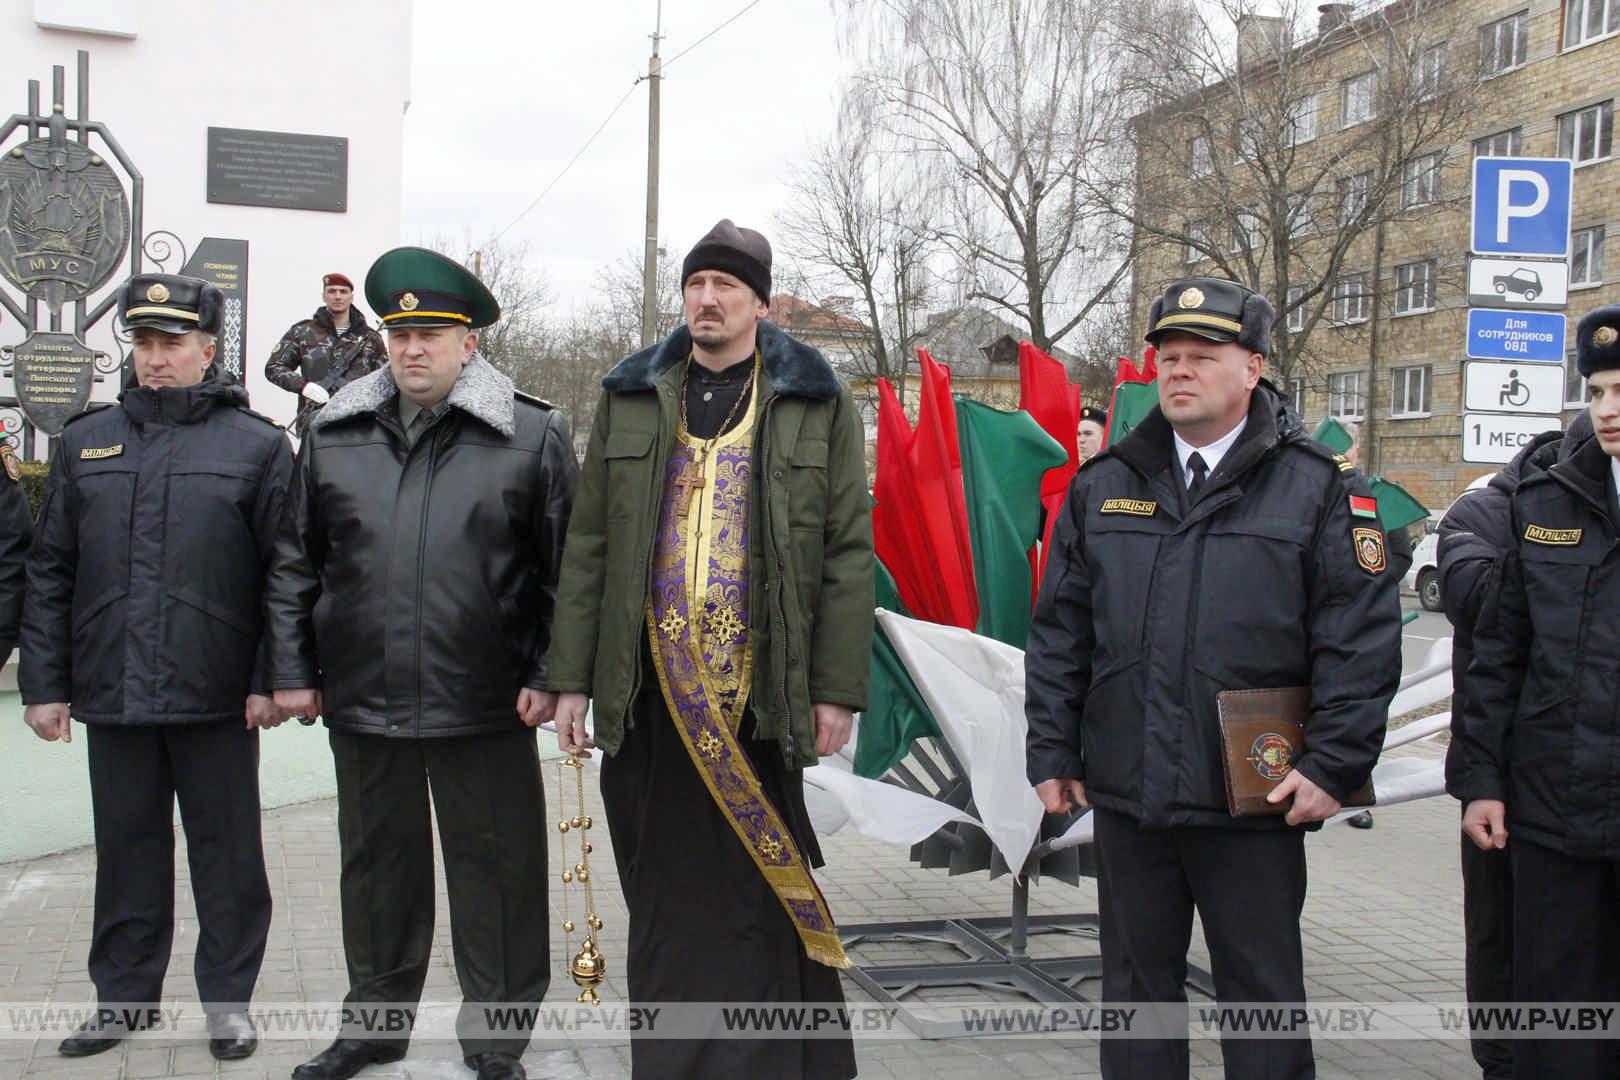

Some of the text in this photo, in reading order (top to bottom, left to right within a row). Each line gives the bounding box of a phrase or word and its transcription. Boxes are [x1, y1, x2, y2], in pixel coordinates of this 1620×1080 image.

[1497, 169, 1550, 243] P
[30, 257, 80, 274] МУС
[1504, 341, 1528, 352] ОВД
[1473, 424, 1481, 445] 1
